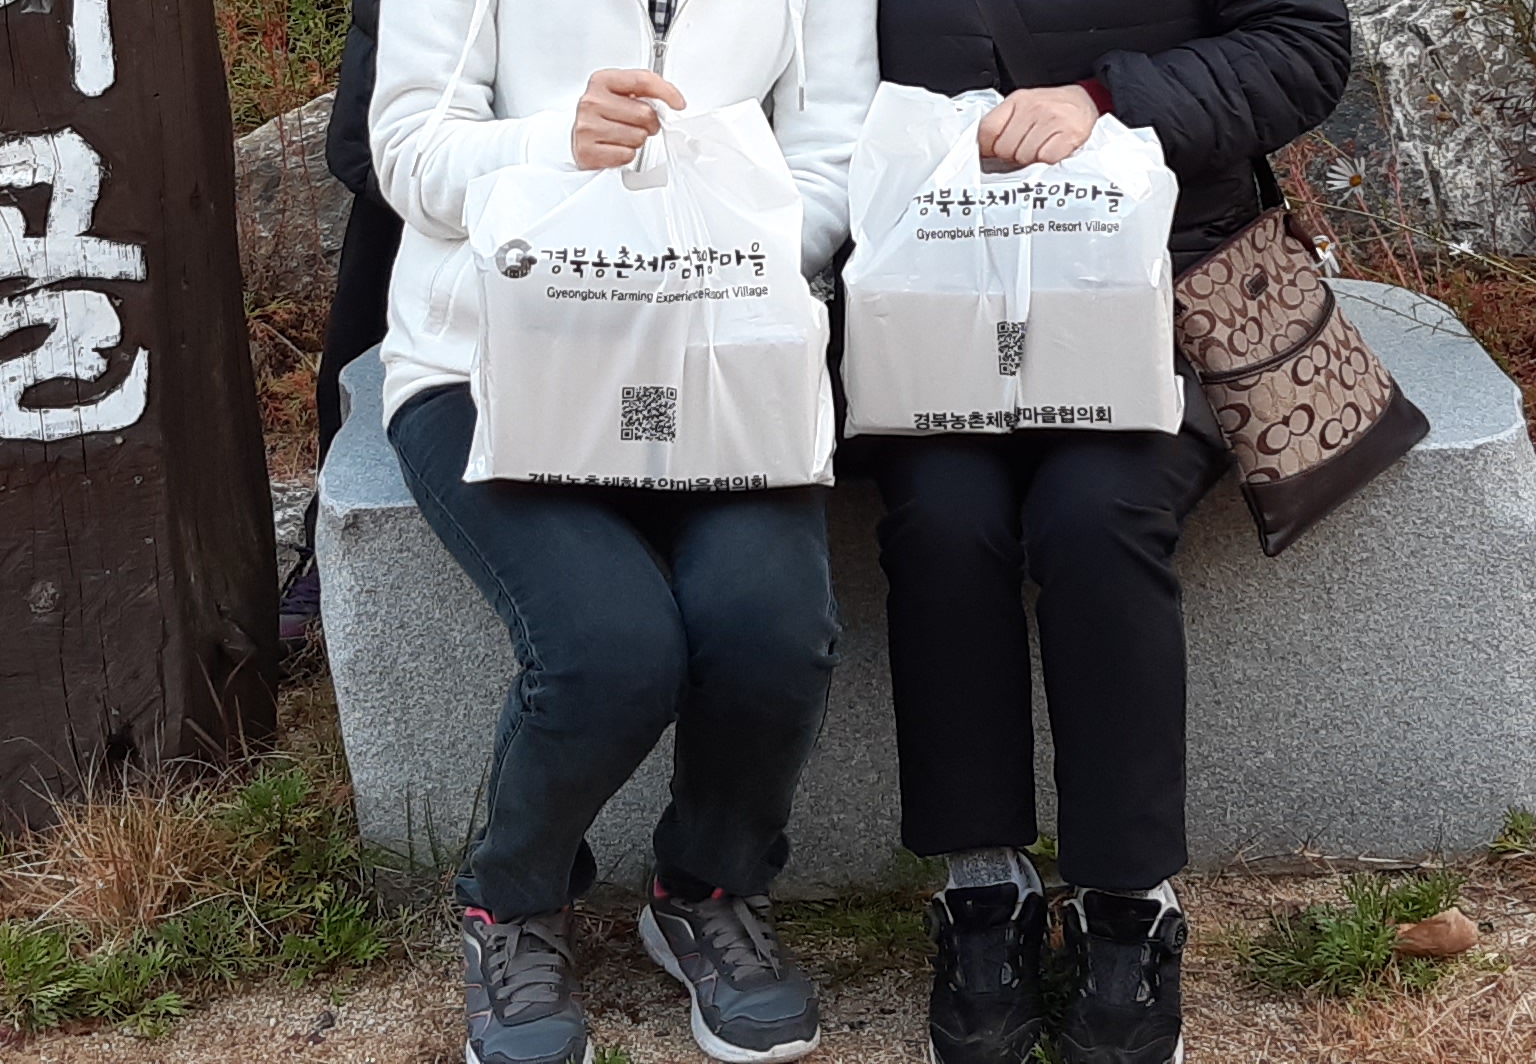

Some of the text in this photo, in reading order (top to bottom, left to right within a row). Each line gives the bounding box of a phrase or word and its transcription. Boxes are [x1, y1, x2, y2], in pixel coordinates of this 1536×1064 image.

[916, 227, 975, 241] Gyeongbuk
[1048, 219, 1082, 232] Resort
[1085, 217, 1120, 232] Village
[546, 286, 608, 302] Gyeongbuk
[611, 288, 654, 303] Farming
[732, 285, 769, 298] Village
